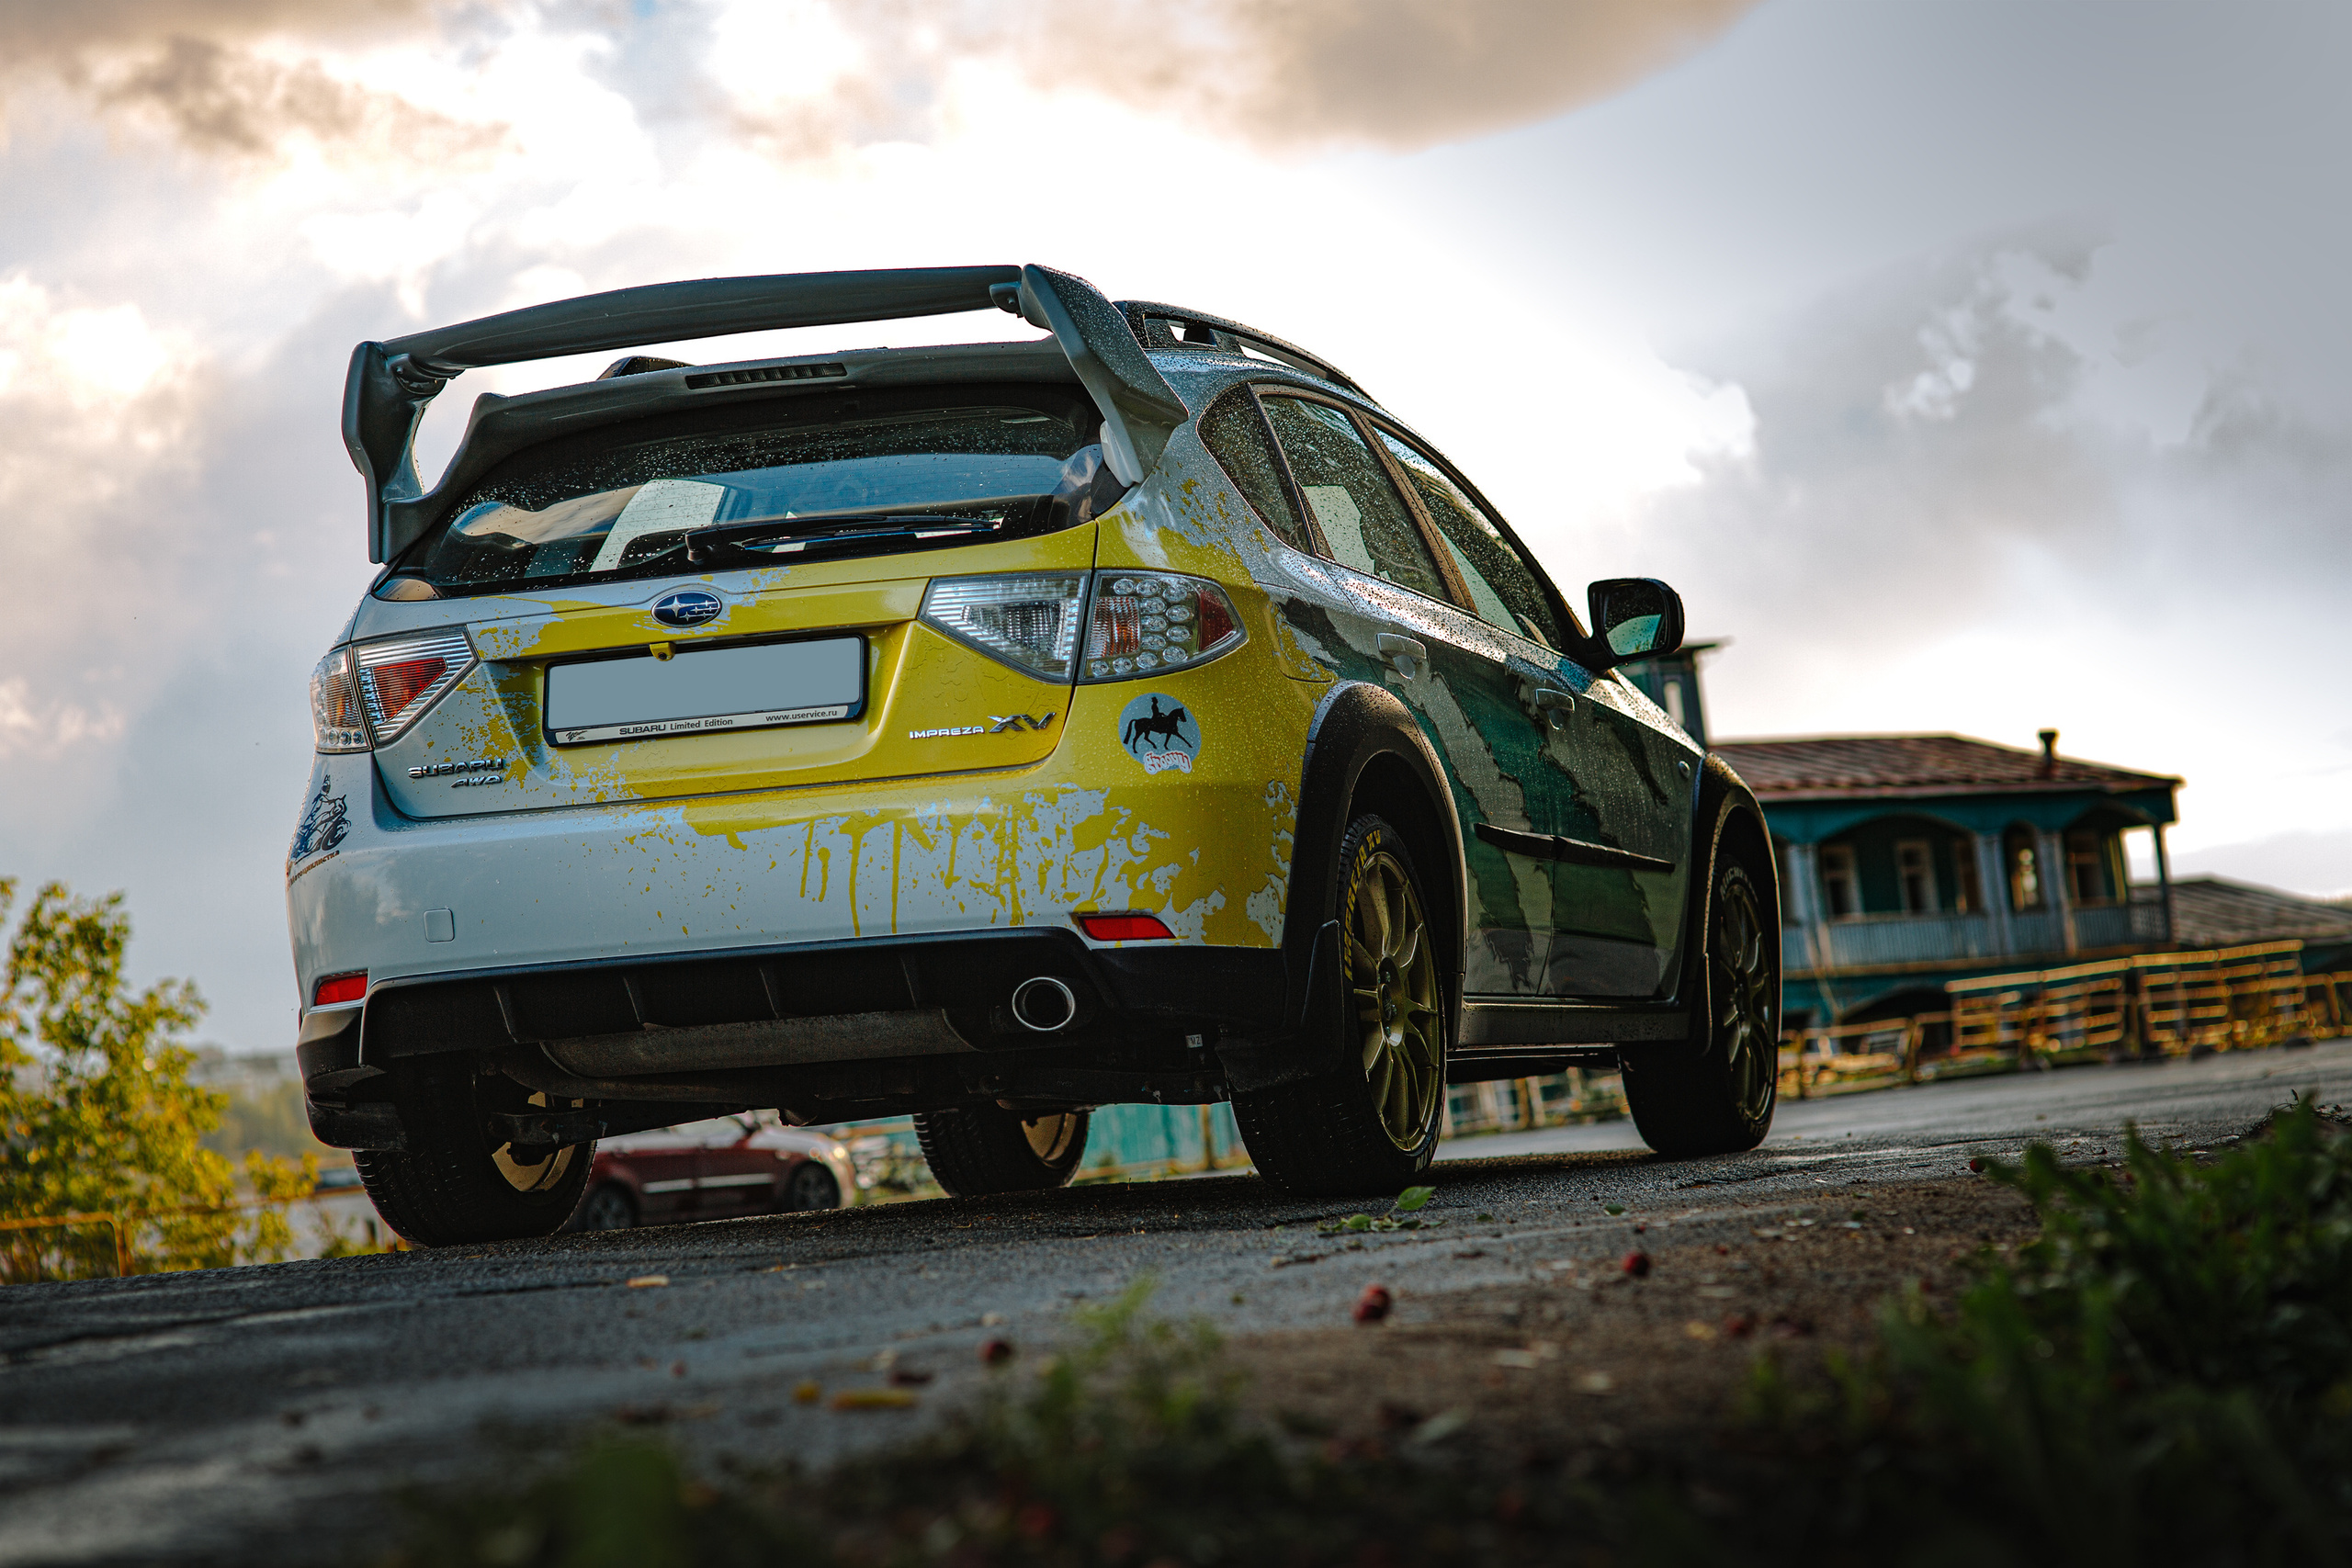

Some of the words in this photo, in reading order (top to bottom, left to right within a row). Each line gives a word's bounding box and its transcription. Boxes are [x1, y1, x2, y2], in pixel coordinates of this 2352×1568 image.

[619, 724, 666, 735] SUBARU
[670, 720, 701, 731] Limited
[704, 718, 733, 728] Edition
[765, 710, 838, 722] www.uservice.ru
[909, 726, 986, 739] IMPREZA
[988, 712, 1057, 733] XV
[407, 758, 503, 779] SUBARU
[1144, 751, 1191, 773] groovy
[450, 775, 503, 788] AWD
[1344, 844, 1367, 982] IMPREZA
[1366, 829, 1381, 852] XV
